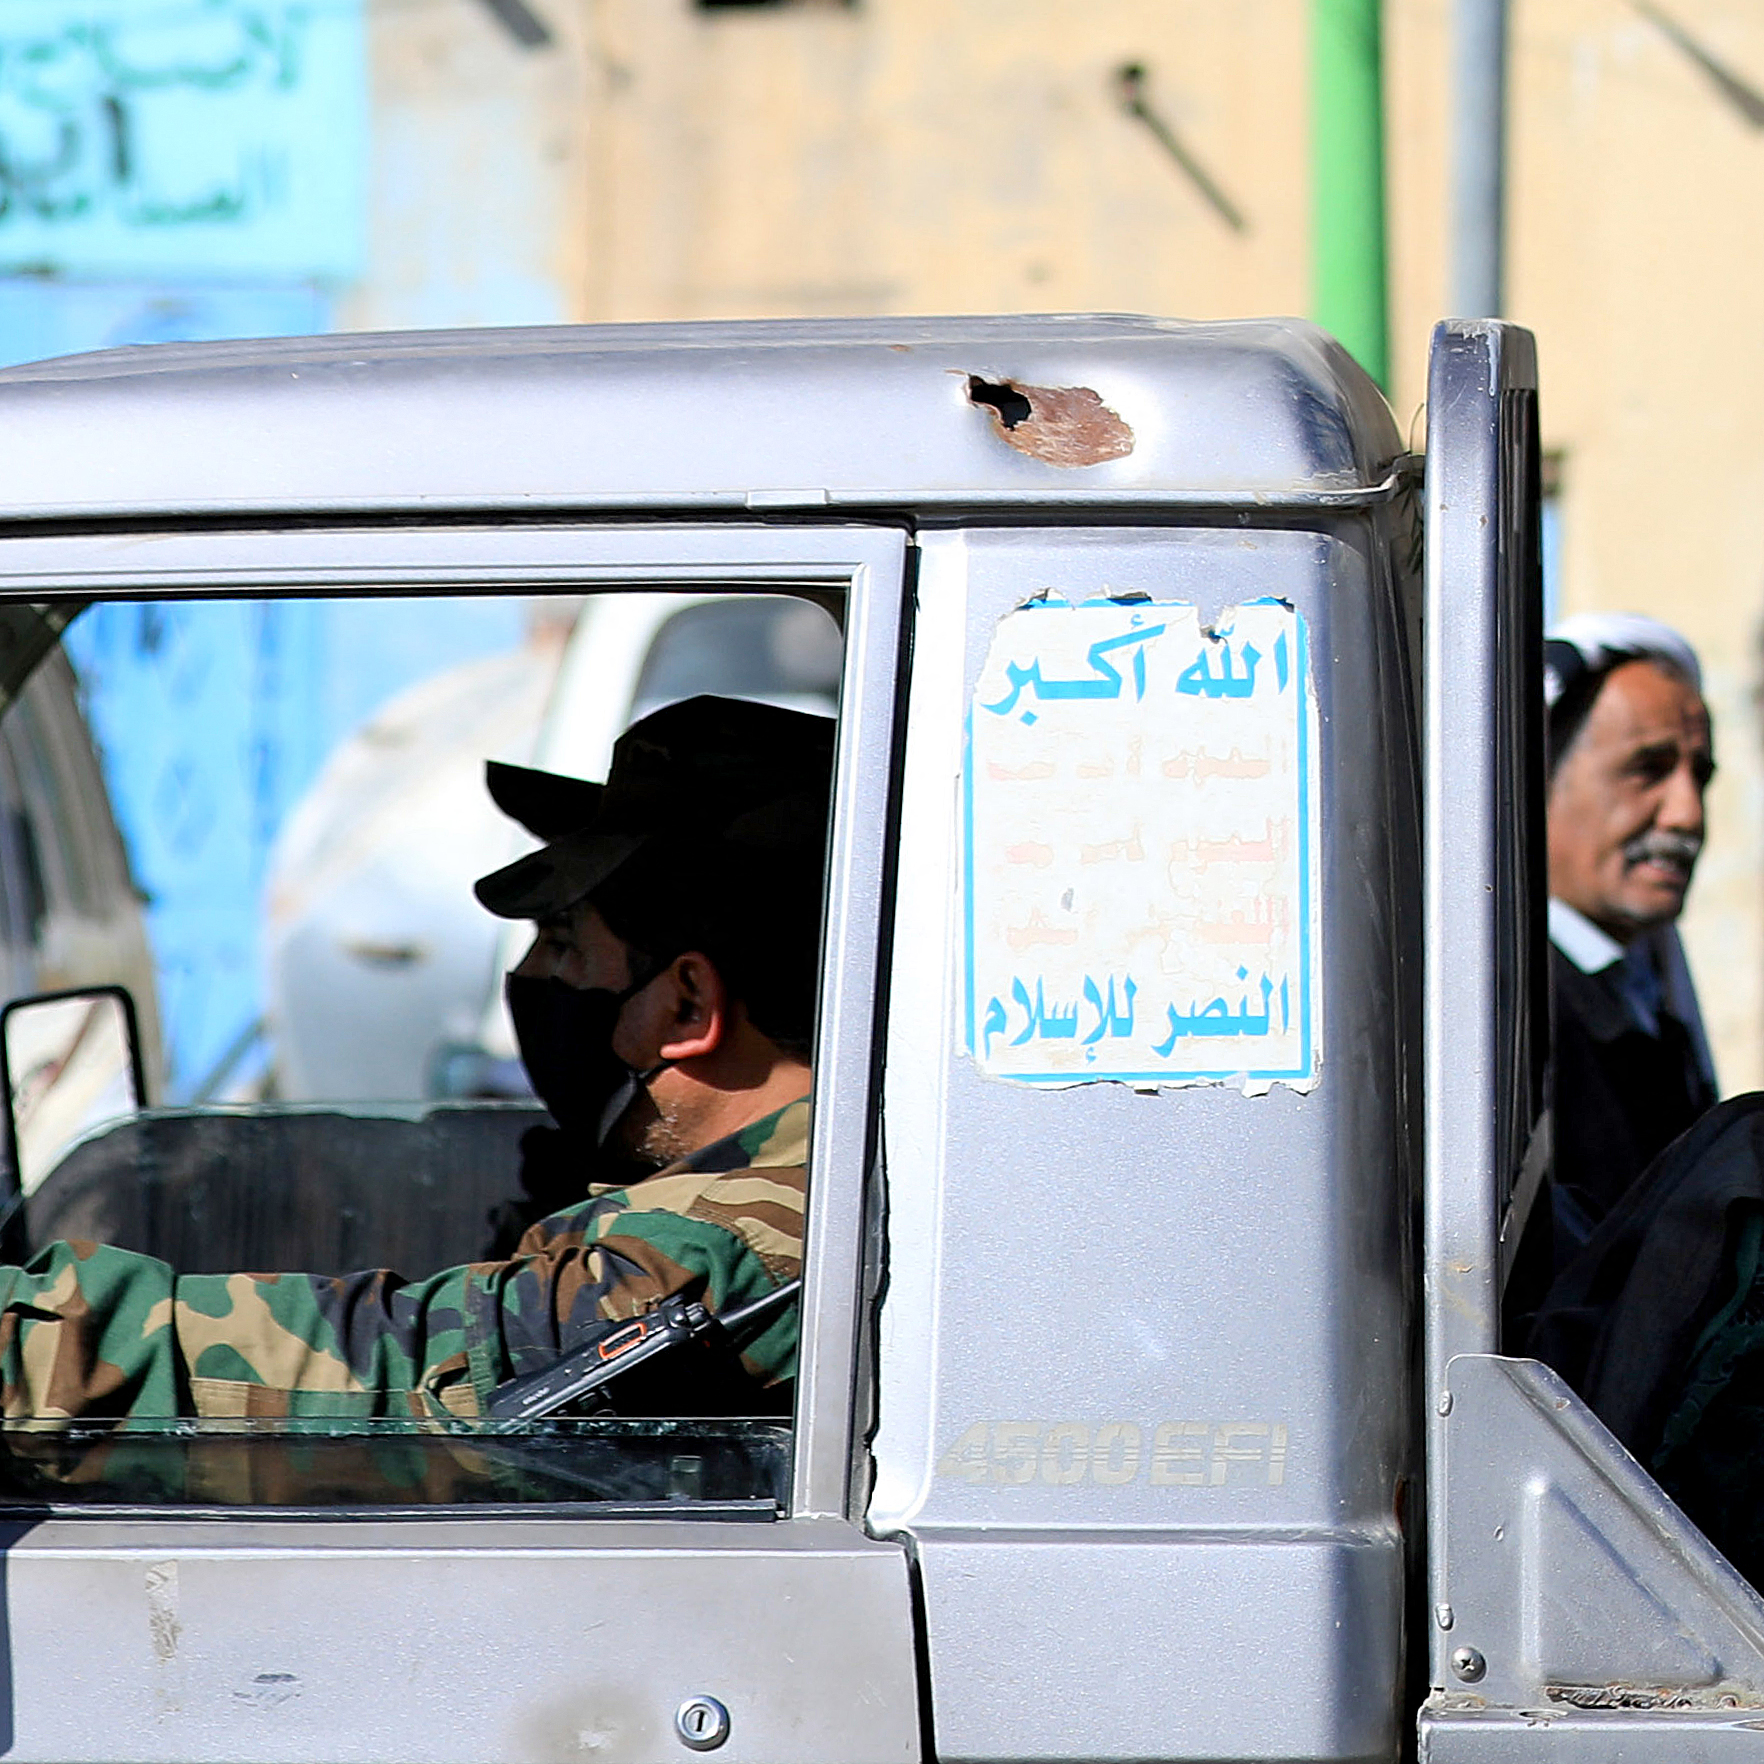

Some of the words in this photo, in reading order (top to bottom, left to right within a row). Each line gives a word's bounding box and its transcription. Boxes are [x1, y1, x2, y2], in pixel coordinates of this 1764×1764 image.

[981, 613, 1167, 727] أكبر
[1174, 625, 1290, 700] الله
[981, 974, 1139, 1065] للإسلام
[1150, 965, 1290, 1058] النصر
[936, 1420, 1143, 1486] 4500
[1147, 1421, 1289, 1487] EFI
